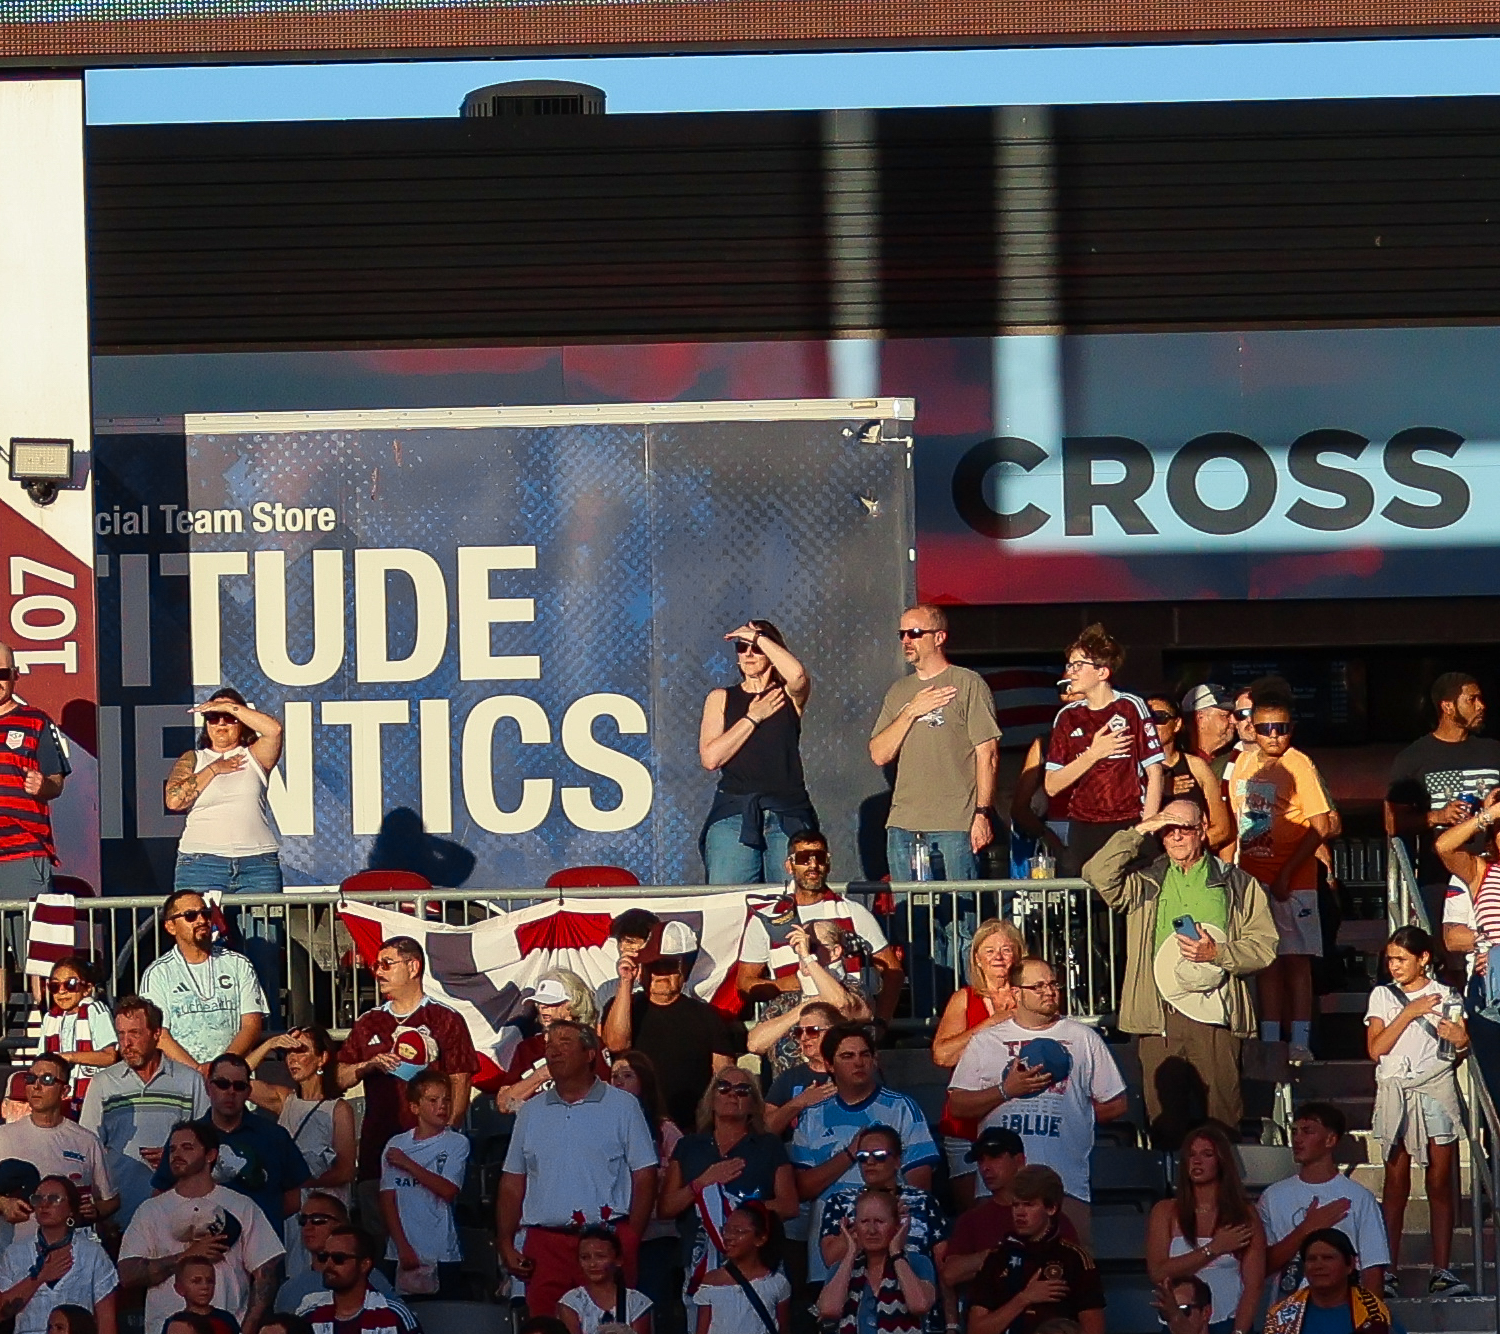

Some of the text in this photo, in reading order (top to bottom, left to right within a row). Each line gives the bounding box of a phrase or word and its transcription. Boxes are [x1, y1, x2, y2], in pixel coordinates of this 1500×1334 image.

[95, 501, 336, 535] cial Team Store
[952, 426, 1471, 539] CROSS
[9, 555, 78, 674] 107
[1010, 1114, 1062, 1138] BLUE
